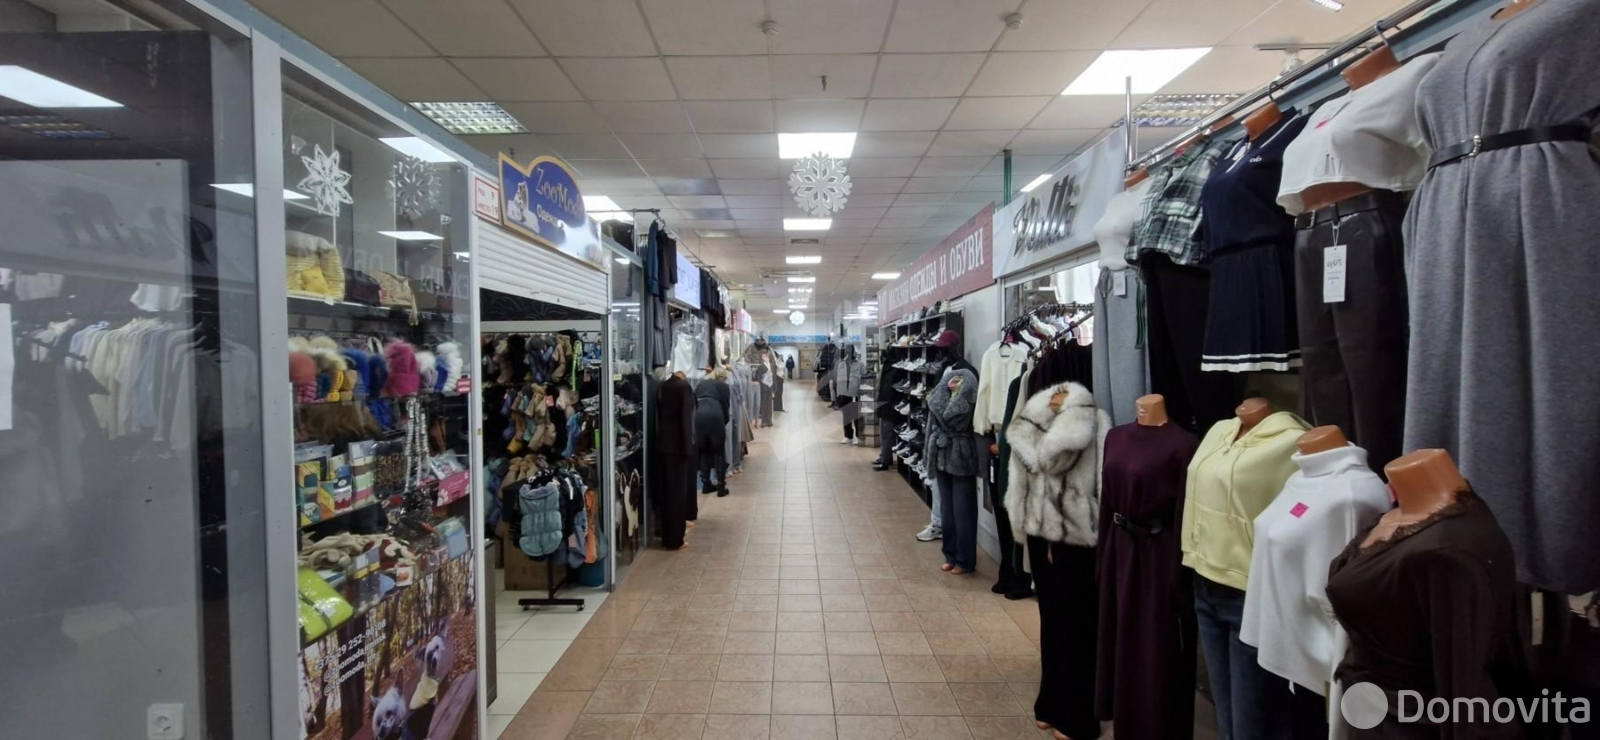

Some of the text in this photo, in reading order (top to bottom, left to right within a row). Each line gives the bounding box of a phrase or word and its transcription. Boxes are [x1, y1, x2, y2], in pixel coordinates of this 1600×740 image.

[909, 260, 937, 300] ОДЕЖДЫ
[940, 254, 946, 286] И
[949, 227, 984, 280] ОБУВИ
